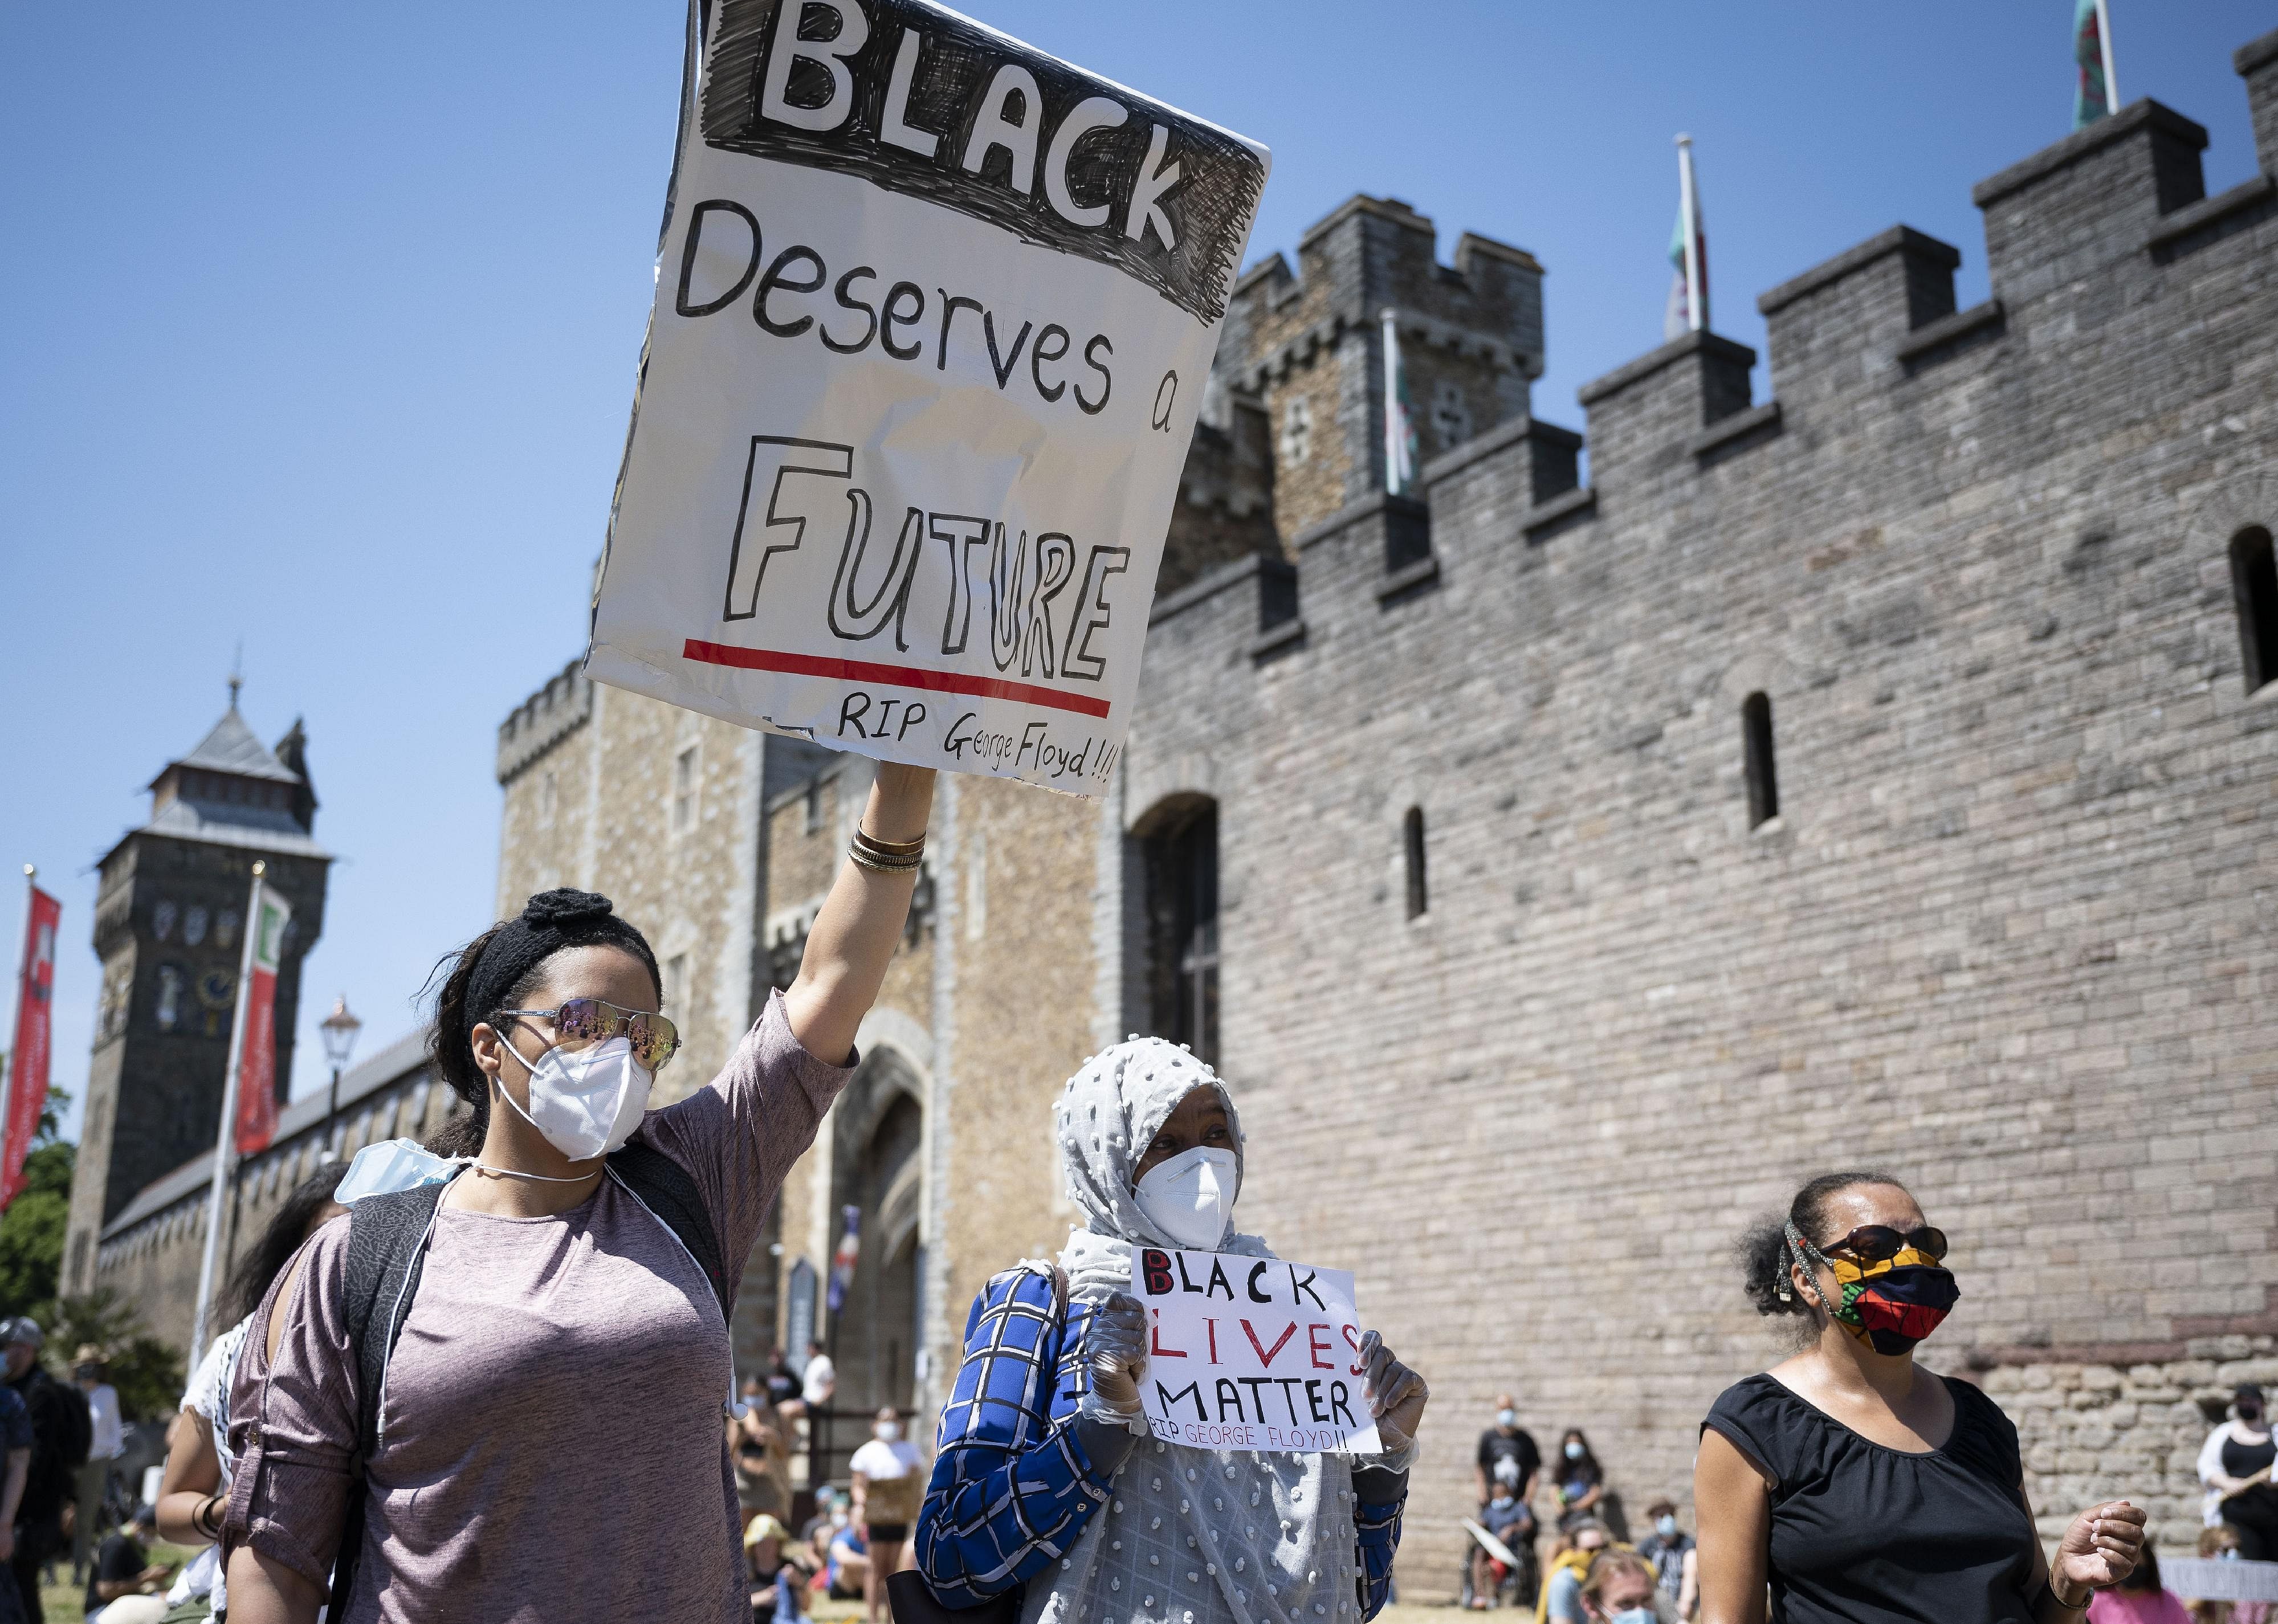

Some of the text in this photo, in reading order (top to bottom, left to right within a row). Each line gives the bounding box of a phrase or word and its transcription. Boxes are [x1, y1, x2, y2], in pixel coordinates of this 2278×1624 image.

[761, 0, 1182, 251] BLACK
[676, 199, 1178, 433] Deserves a
[837, 691, 926, 741] RIP
[943, 712, 1012, 771] George
[1141, 1247, 1326, 1312] BLACK
[1150, 1308, 1363, 1376] LIVES
[1148, 1415, 1179, 1439] RIP
[1185, 1424, 1258, 1445] GEORGE
[1155, 1377, 1357, 1428] MATTER
